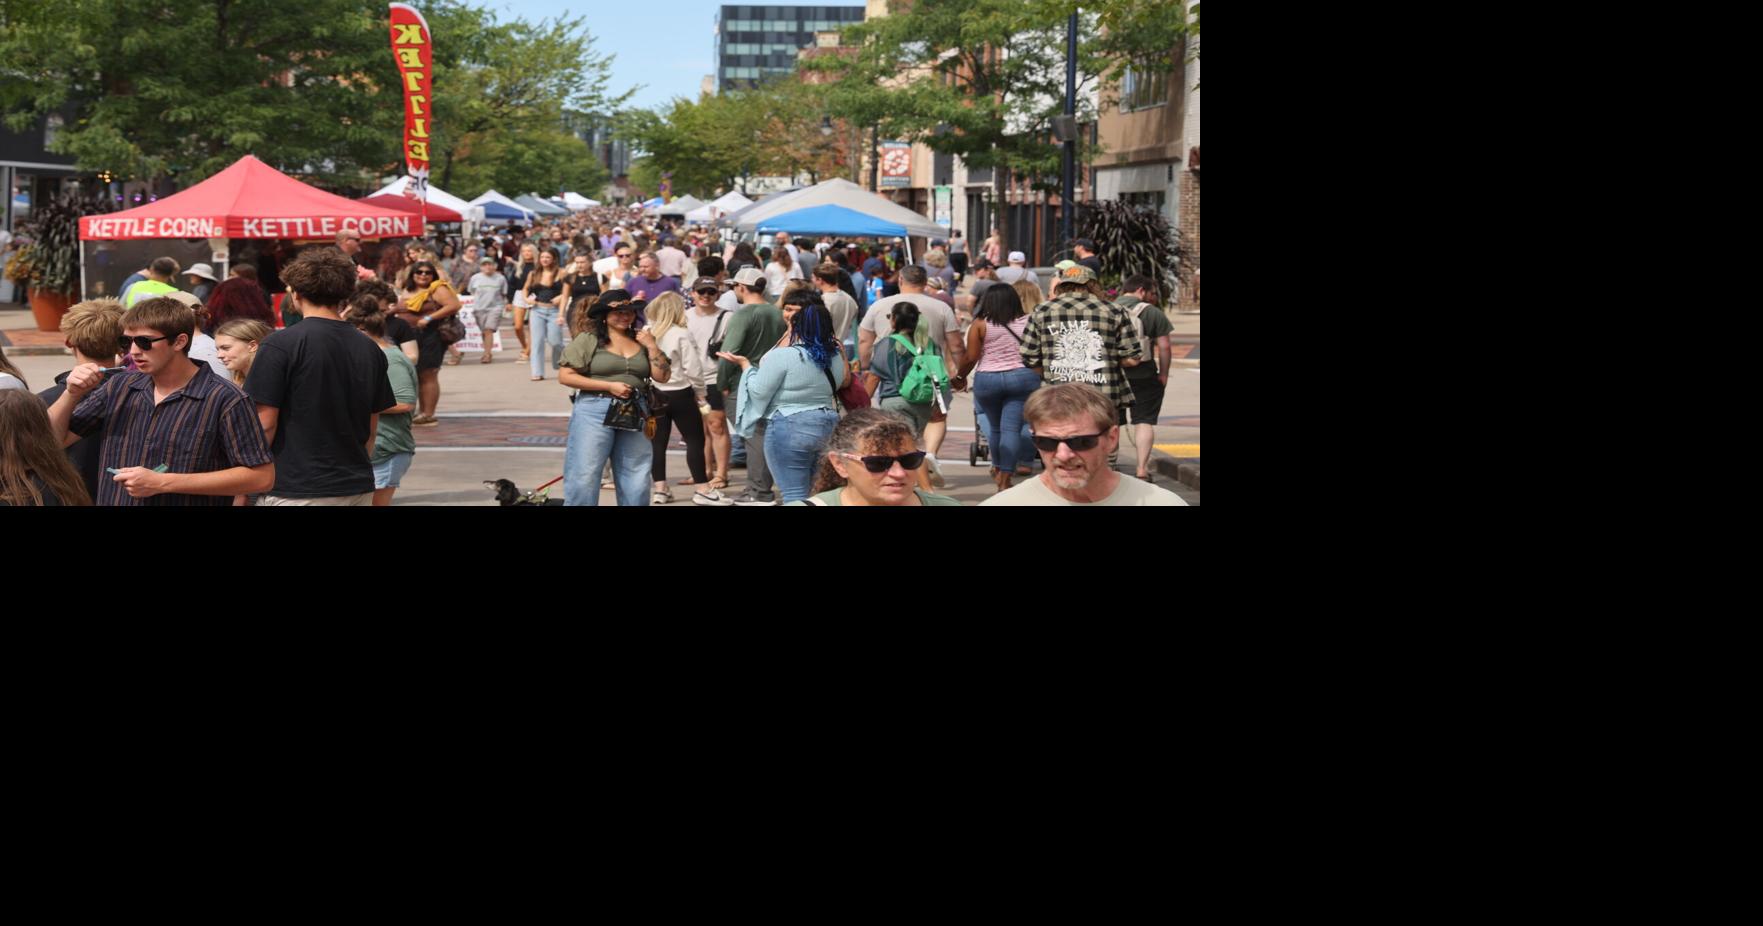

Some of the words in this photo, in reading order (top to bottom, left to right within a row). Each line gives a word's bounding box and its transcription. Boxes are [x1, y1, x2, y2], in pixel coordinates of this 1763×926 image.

[88, 217, 156, 237] KETTLE
[159, 218, 213, 237] CORN
[243, 217, 336, 237] KETTLE
[342, 216, 409, 235] CORN
[1047, 319, 1089, 336] CAMP
